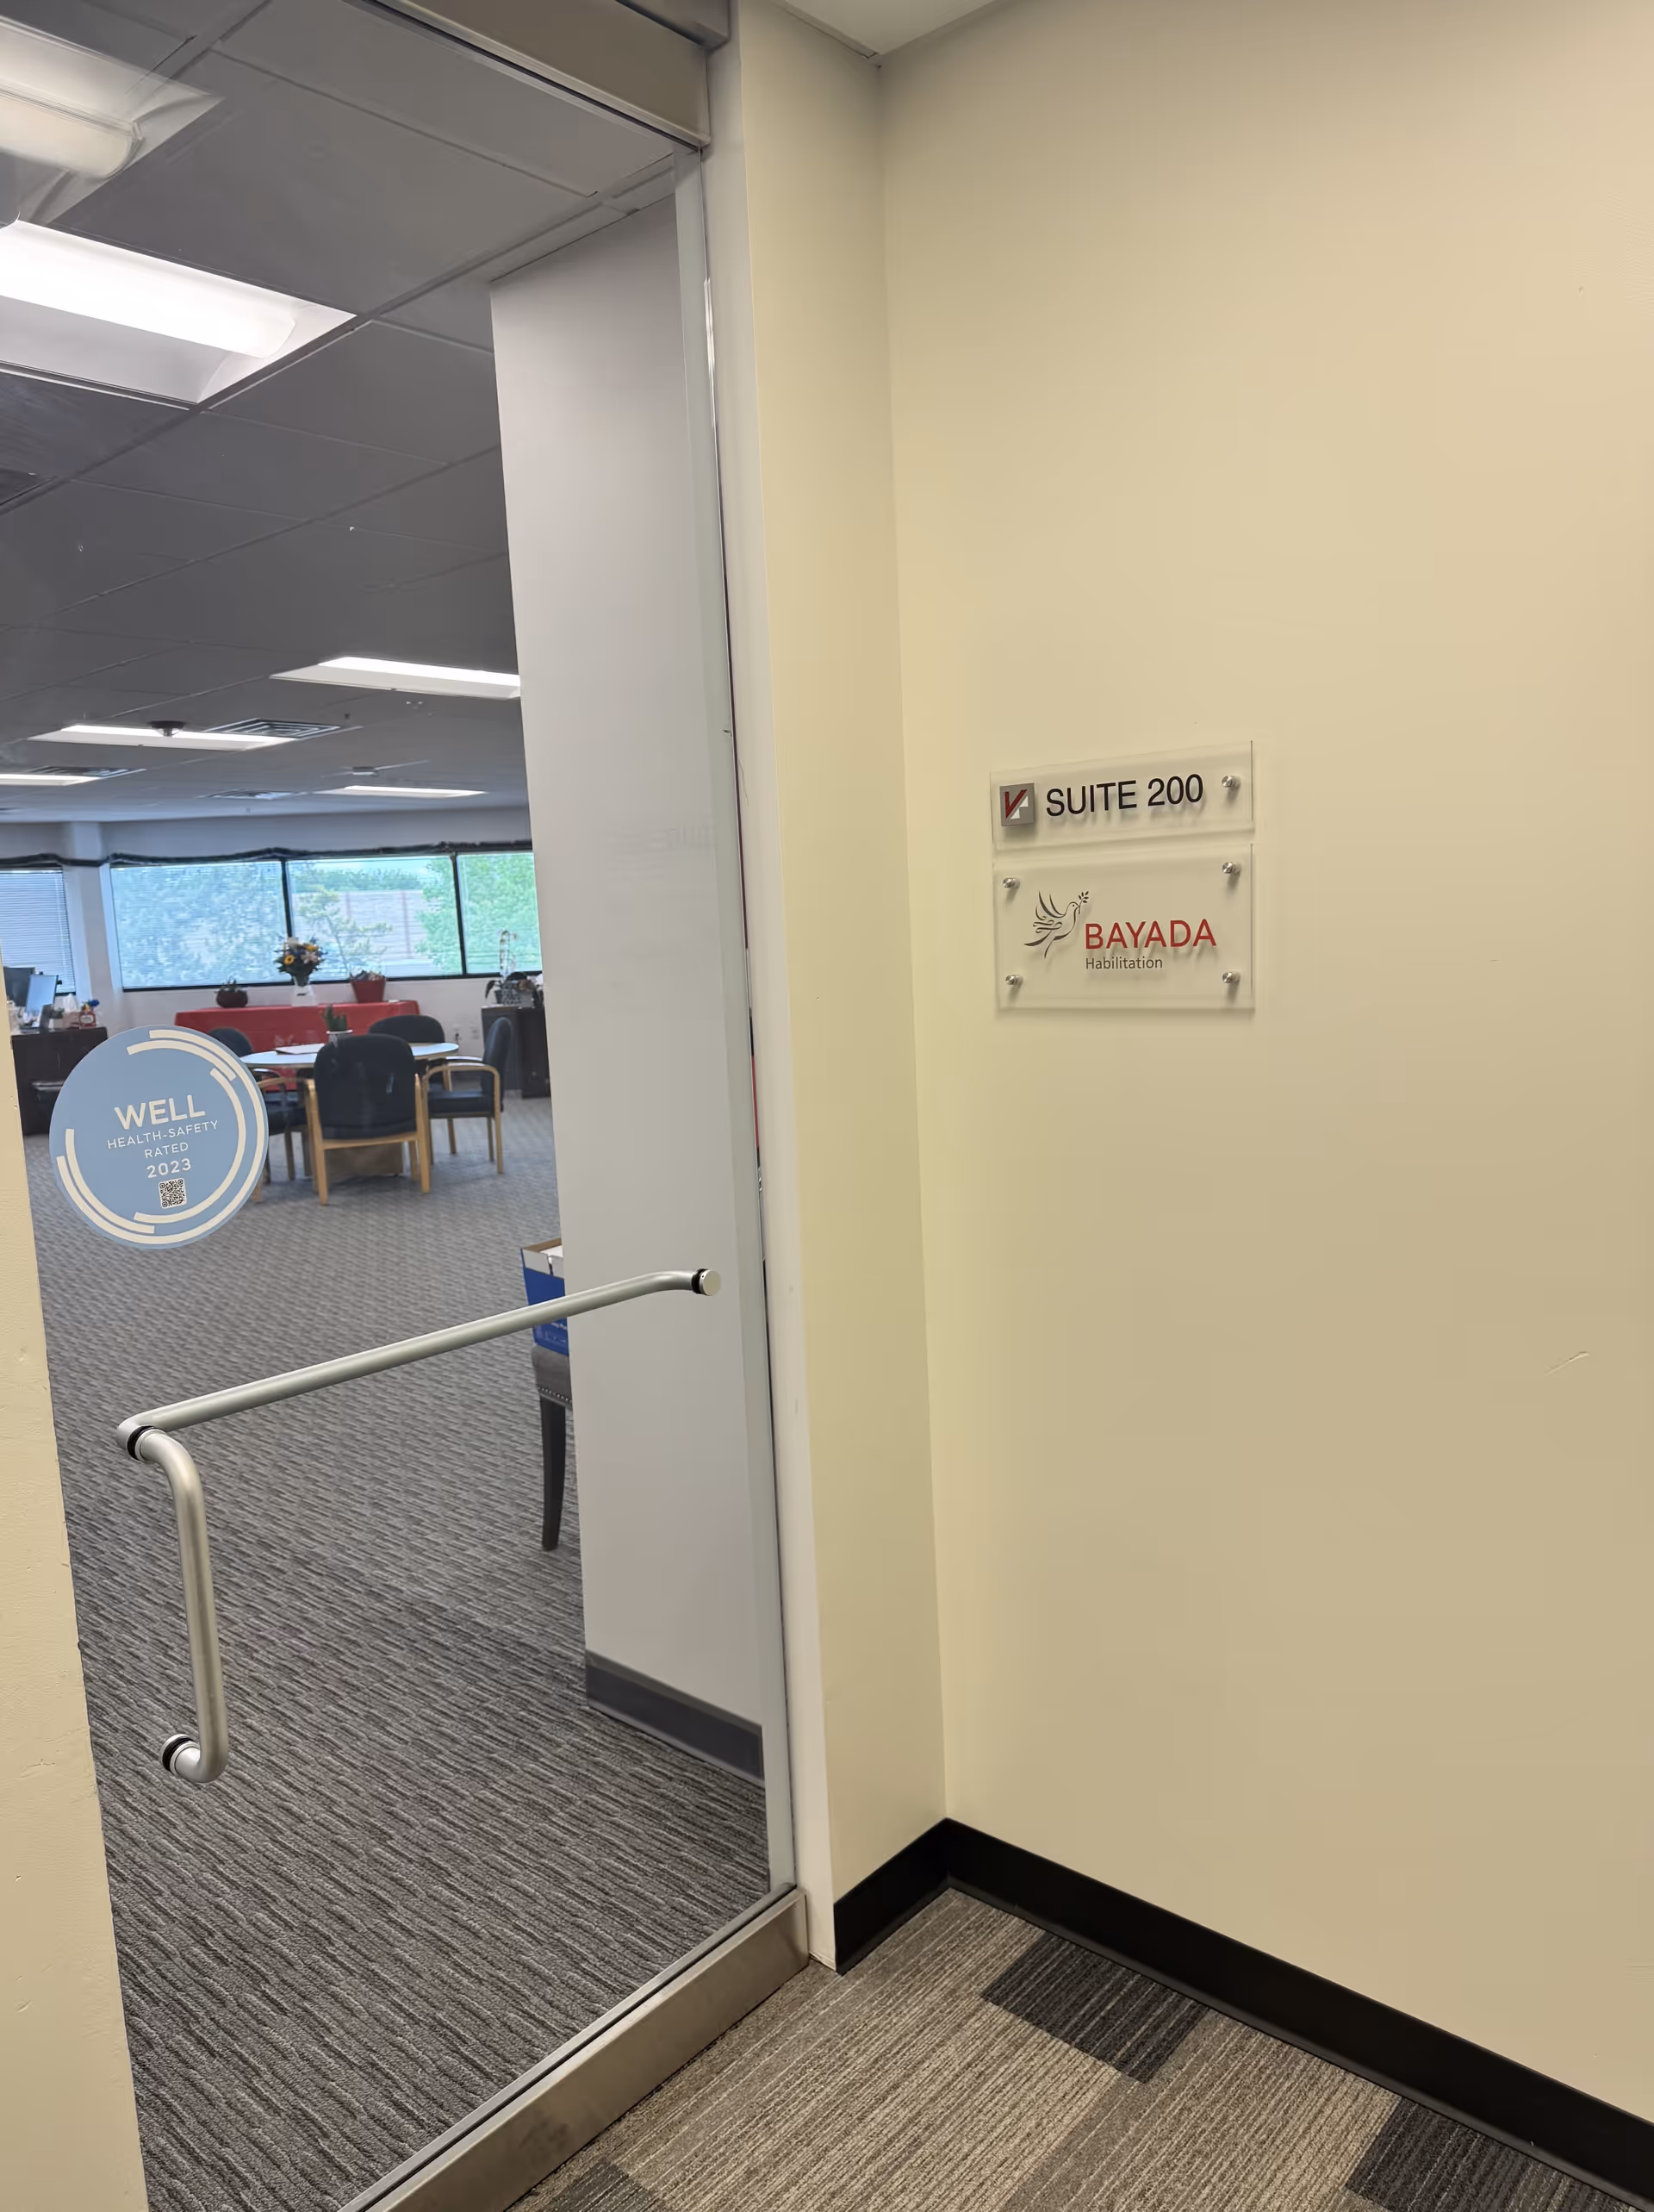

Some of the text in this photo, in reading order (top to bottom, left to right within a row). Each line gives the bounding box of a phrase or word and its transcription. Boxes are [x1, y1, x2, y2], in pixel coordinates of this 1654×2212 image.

[1046, 774, 1203, 816] SUITE 200
[1085, 919, 1216, 949] BAYADA
[1085, 956, 1163, 969] Habilitation
[114, 1094, 206, 1130] WELL
[107, 1119, 218, 1149] HEALTH-SAFETY
[144, 1142, 189, 1158] RATED
[146, 1157, 191, 1178] 2023
